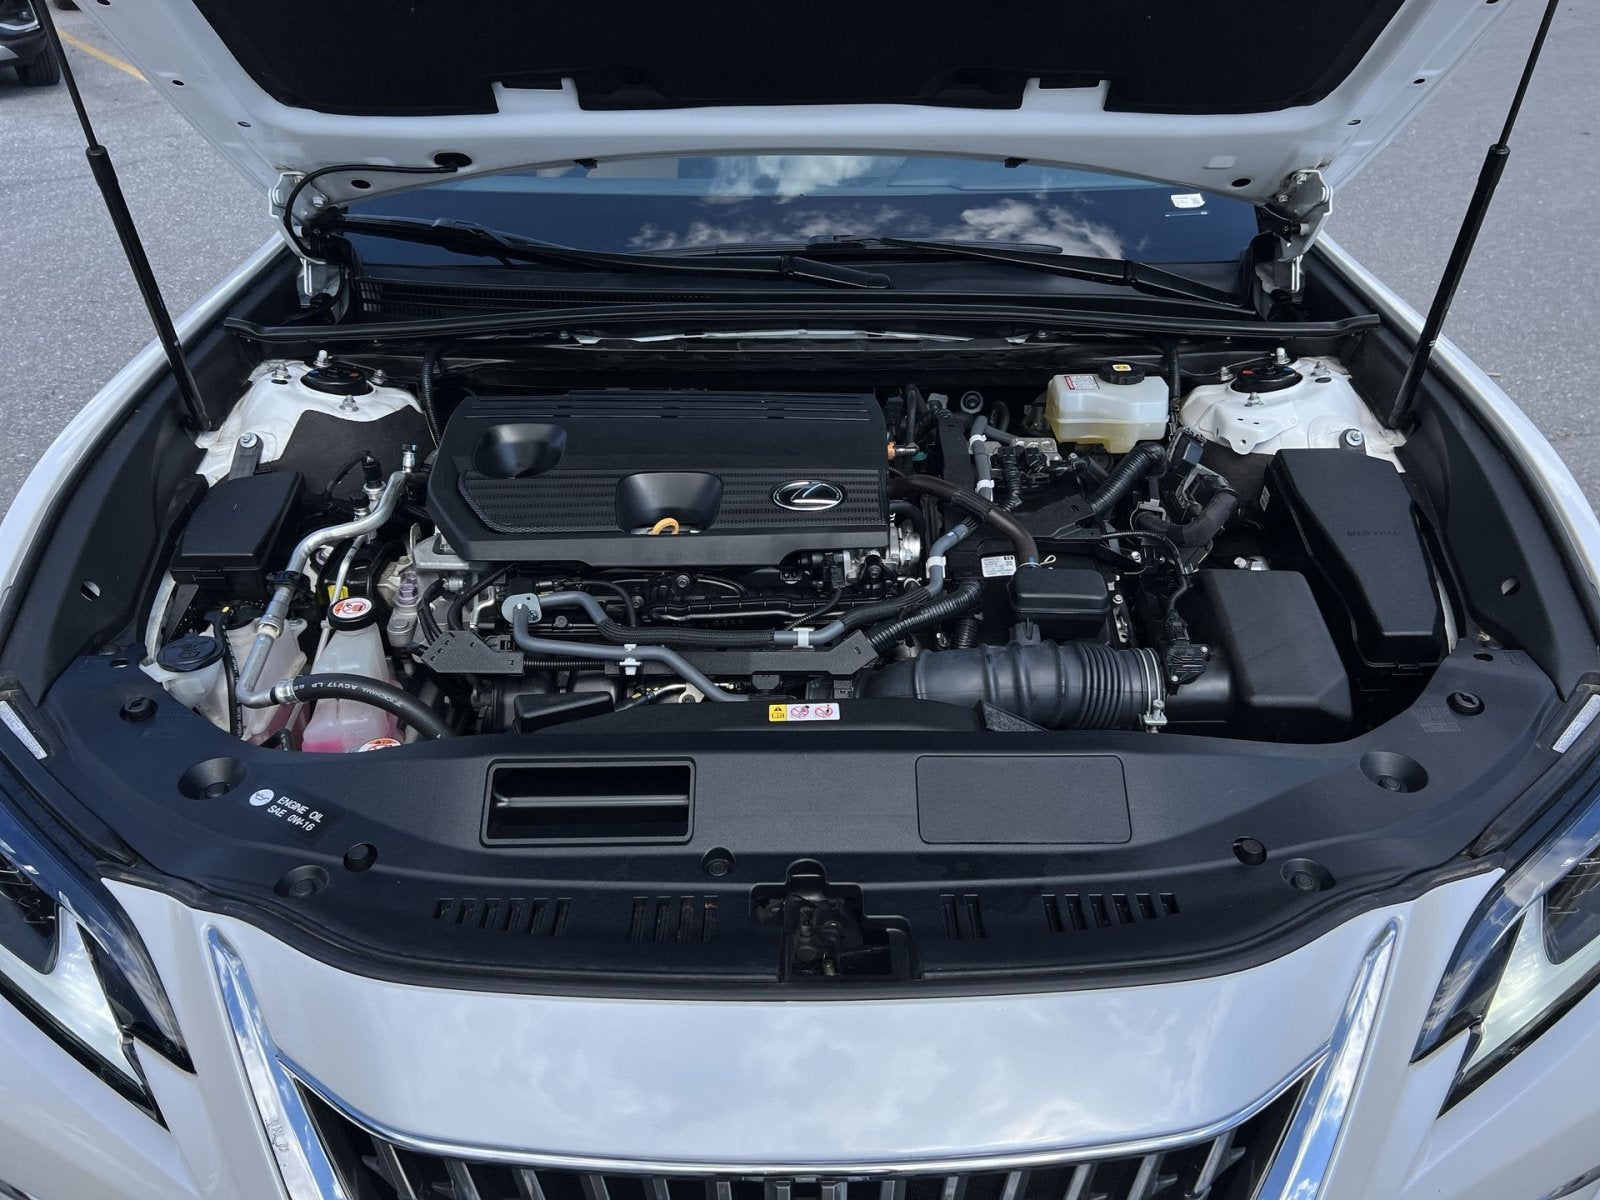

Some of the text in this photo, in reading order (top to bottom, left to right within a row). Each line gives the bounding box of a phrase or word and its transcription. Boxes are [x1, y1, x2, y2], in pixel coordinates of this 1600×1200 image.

[326, 682, 358, 690] ACV17
[267, 805, 315, 831] SAE 0W-16
[276, 796, 323, 823] ENGINE OIL
